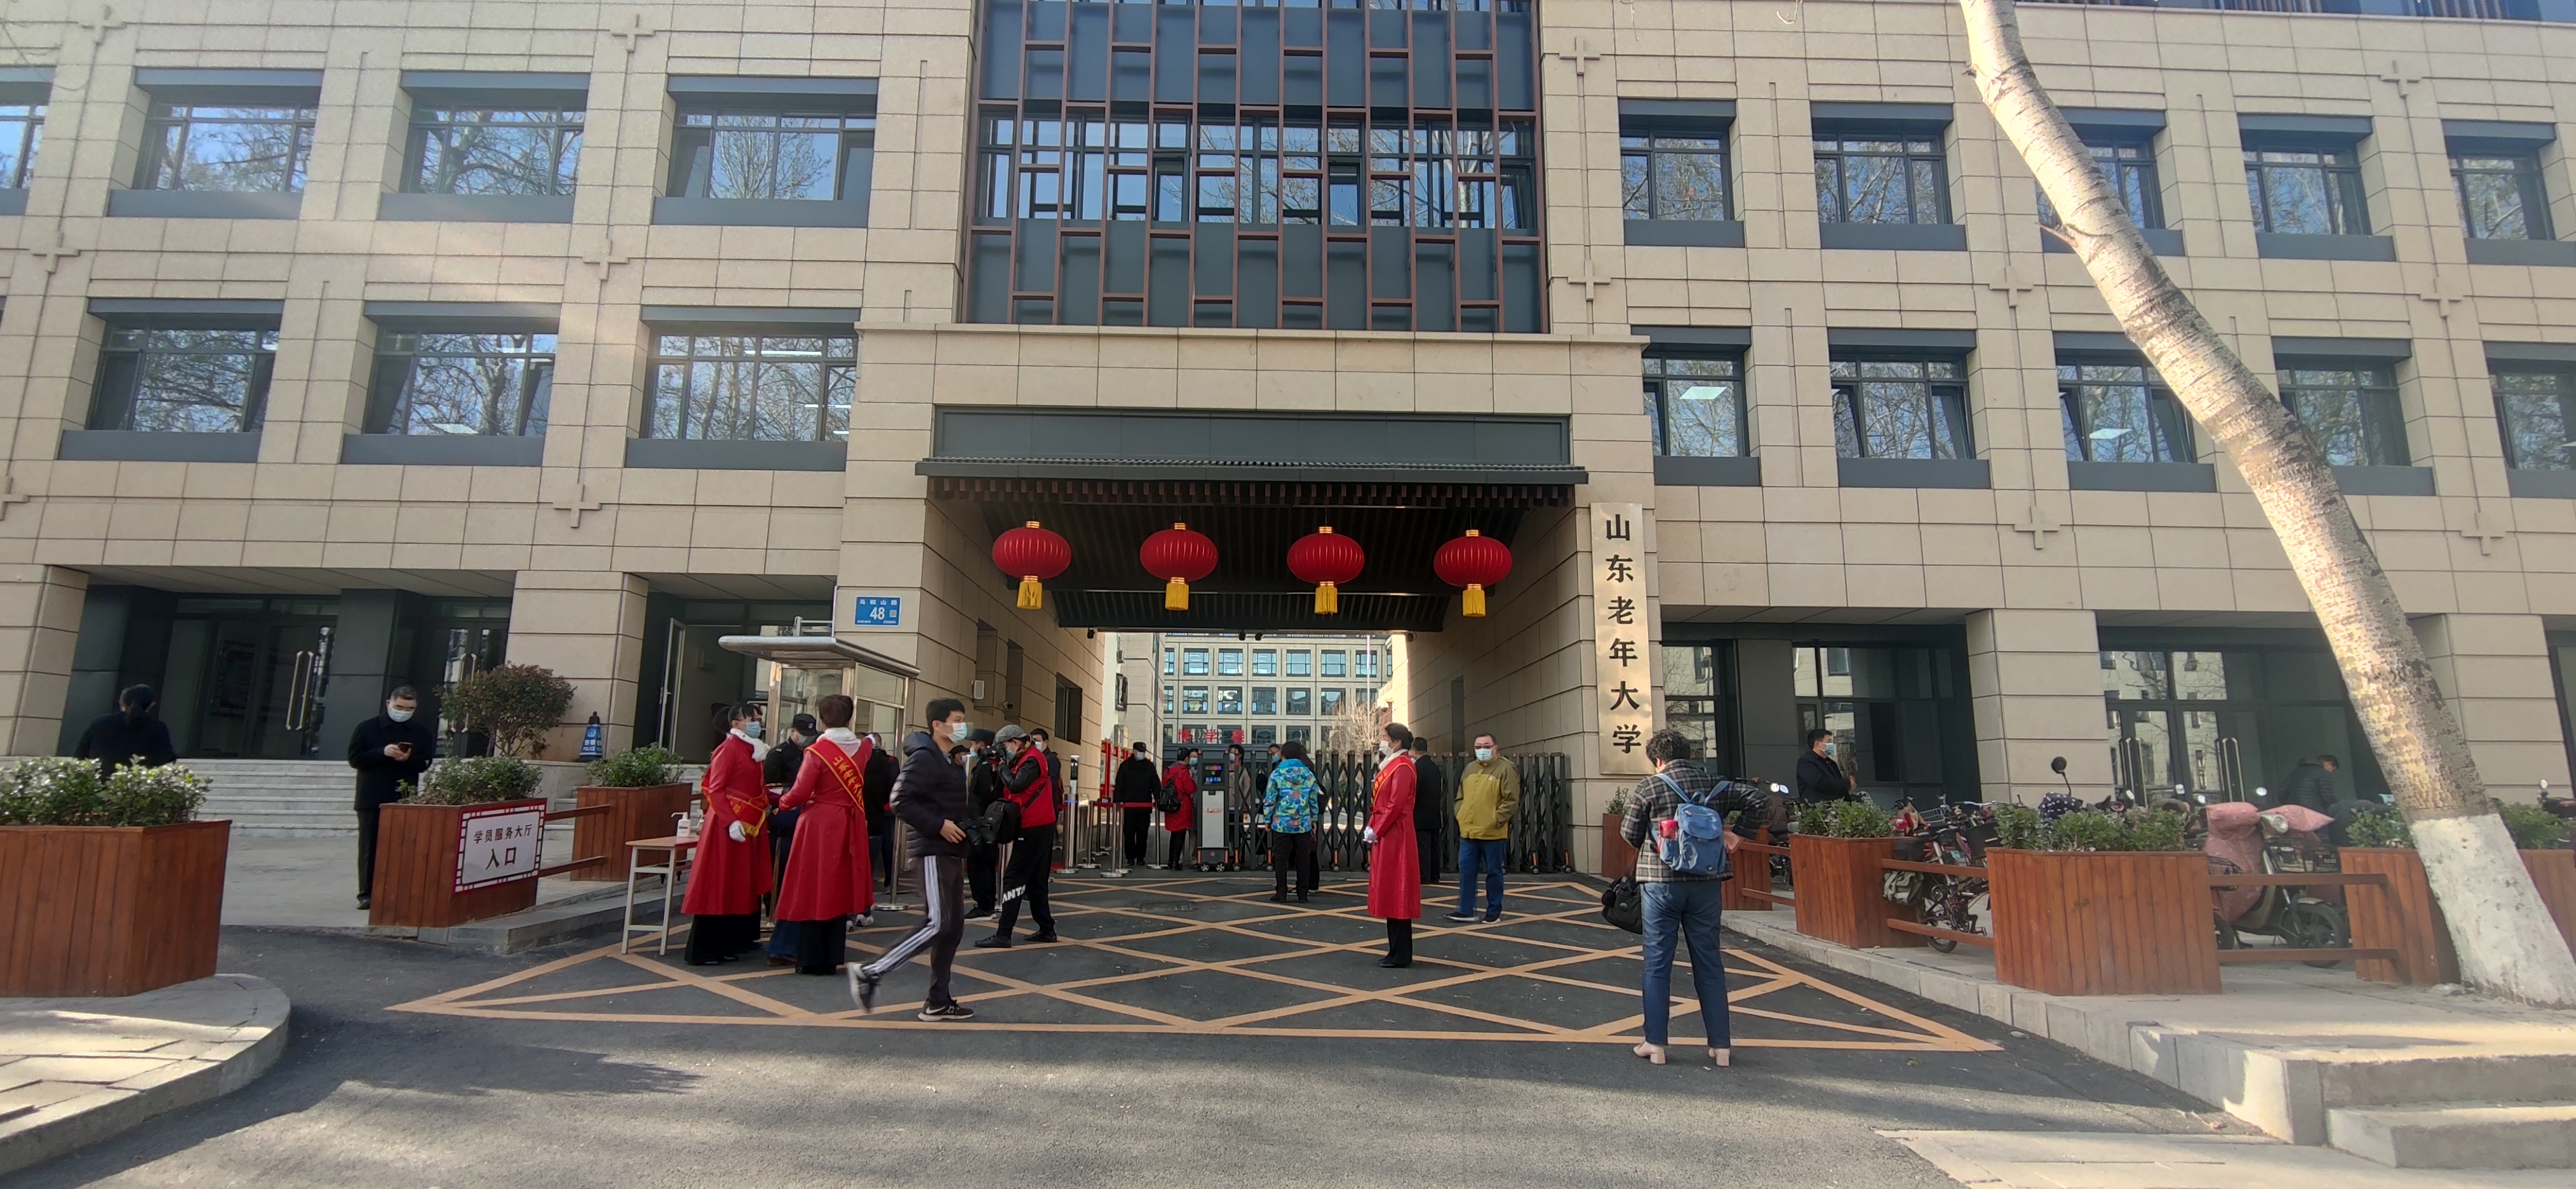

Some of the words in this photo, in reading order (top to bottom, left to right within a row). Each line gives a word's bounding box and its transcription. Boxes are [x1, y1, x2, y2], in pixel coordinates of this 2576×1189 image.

[869, 607, 885, 620] 48
[1606, 513, 1642, 754] 山东老年大学
[473, 823, 533, 844] 学员服务大厅
[485, 846, 517, 870] 入口
